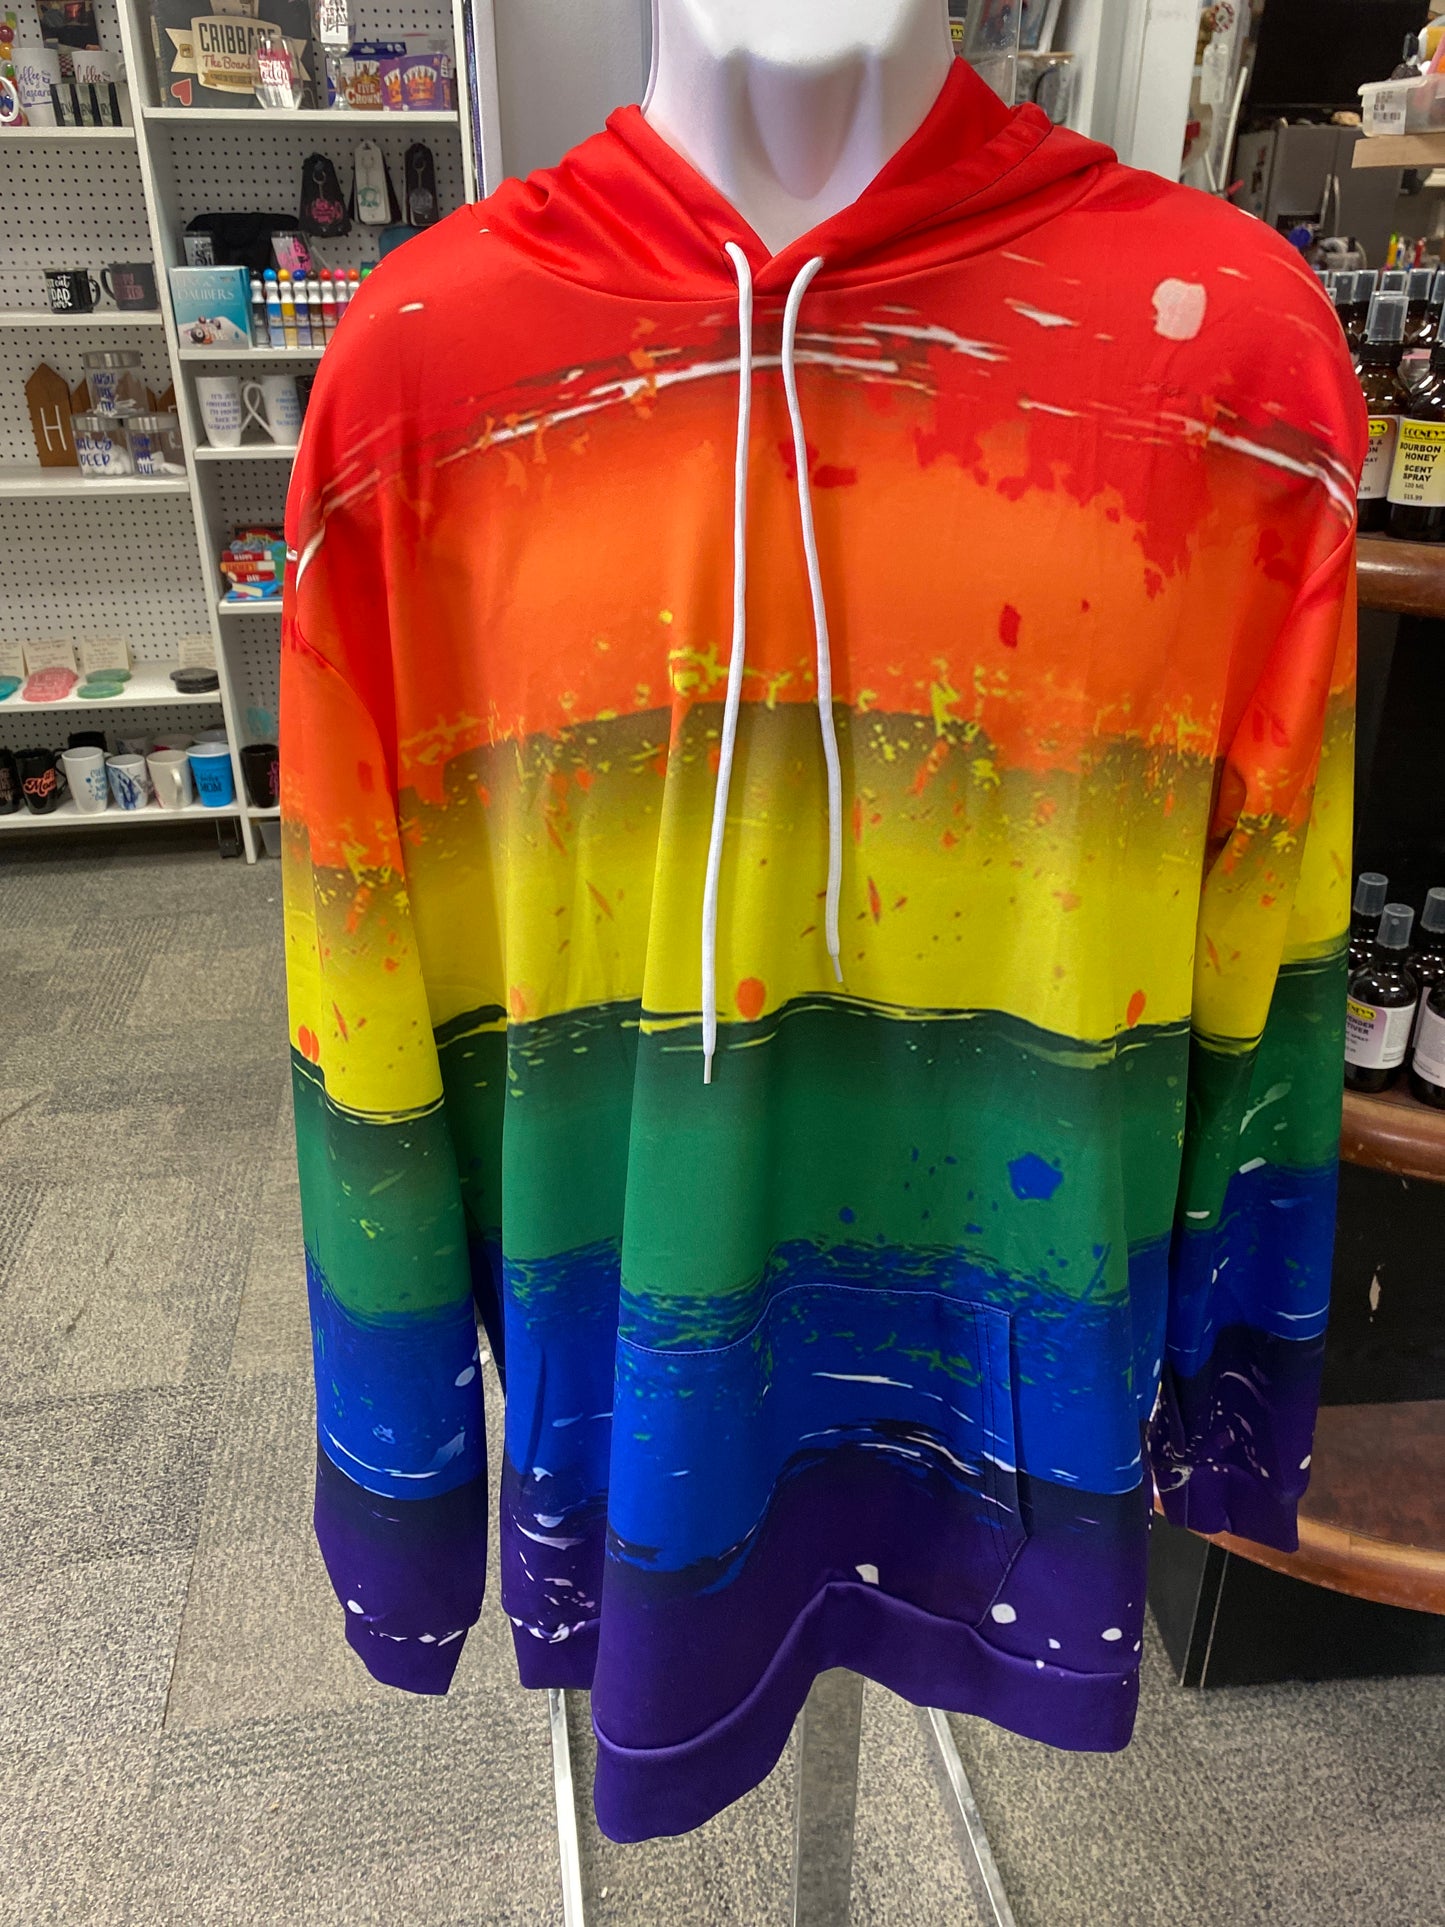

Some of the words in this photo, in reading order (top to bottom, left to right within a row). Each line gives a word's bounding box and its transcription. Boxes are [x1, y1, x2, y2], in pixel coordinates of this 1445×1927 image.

[203, 54, 222, 68] The
[51, 288, 71, 301] DAD
[40, 404, 67, 452] H
[1400, 442, 1442, 453] BOURBON
[1405, 452, 1438, 462] HONEY
[1404, 464, 1433, 474] SCENT
[1403, 473, 1431, 482] SPRAY
[1347, 1015, 1375, 1030] ENDER
